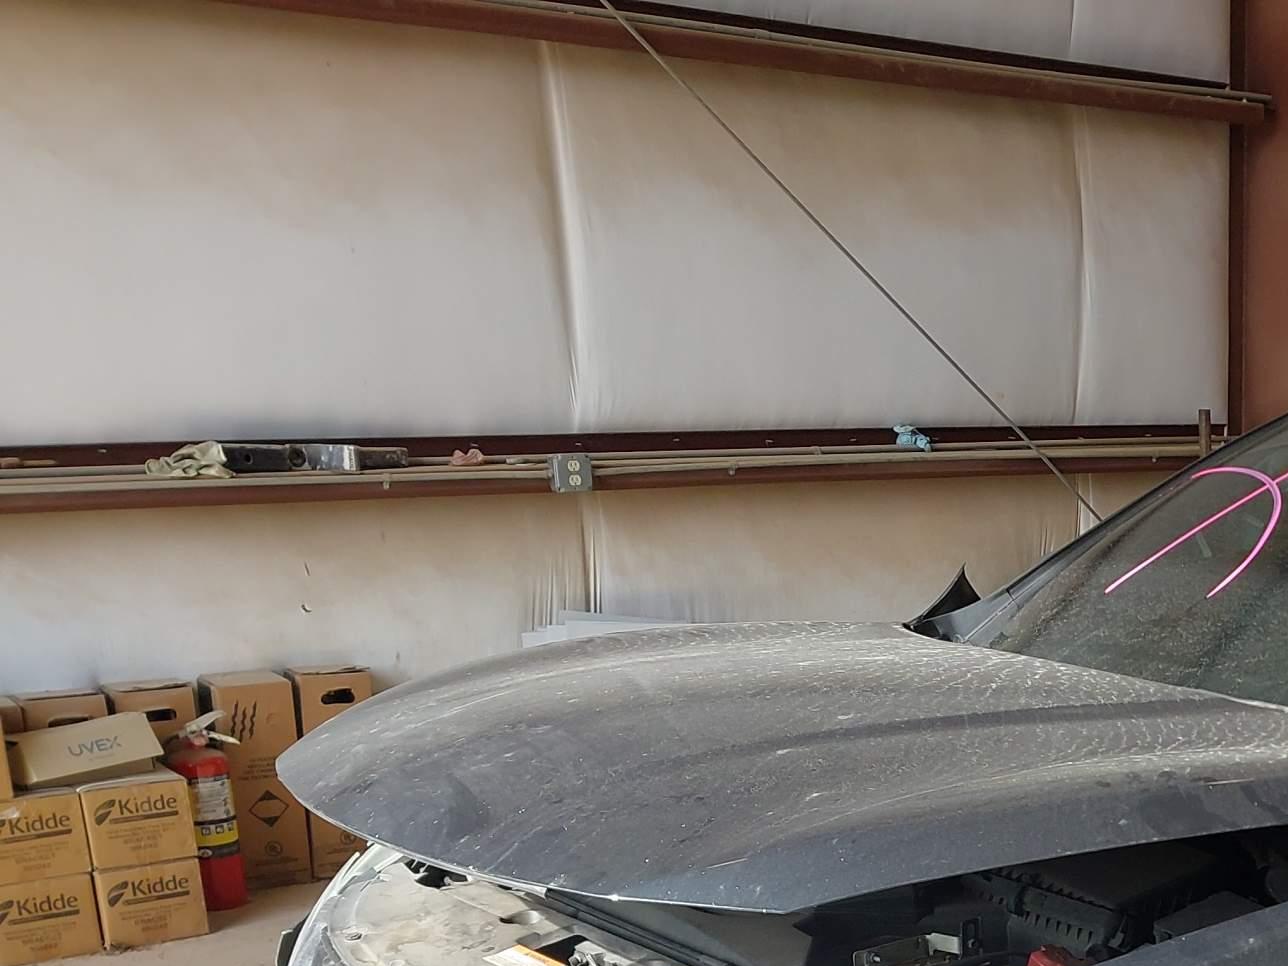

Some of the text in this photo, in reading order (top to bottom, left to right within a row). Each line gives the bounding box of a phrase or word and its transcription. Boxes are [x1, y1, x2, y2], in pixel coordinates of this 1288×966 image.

[68, 736, 122, 757] UVEX
[118, 794, 177, 815] Kidde
[8, 812, 71, 835] Kidde
[131, 874, 189, 897] Kidde
[16, 893, 79, 916] Kidde
